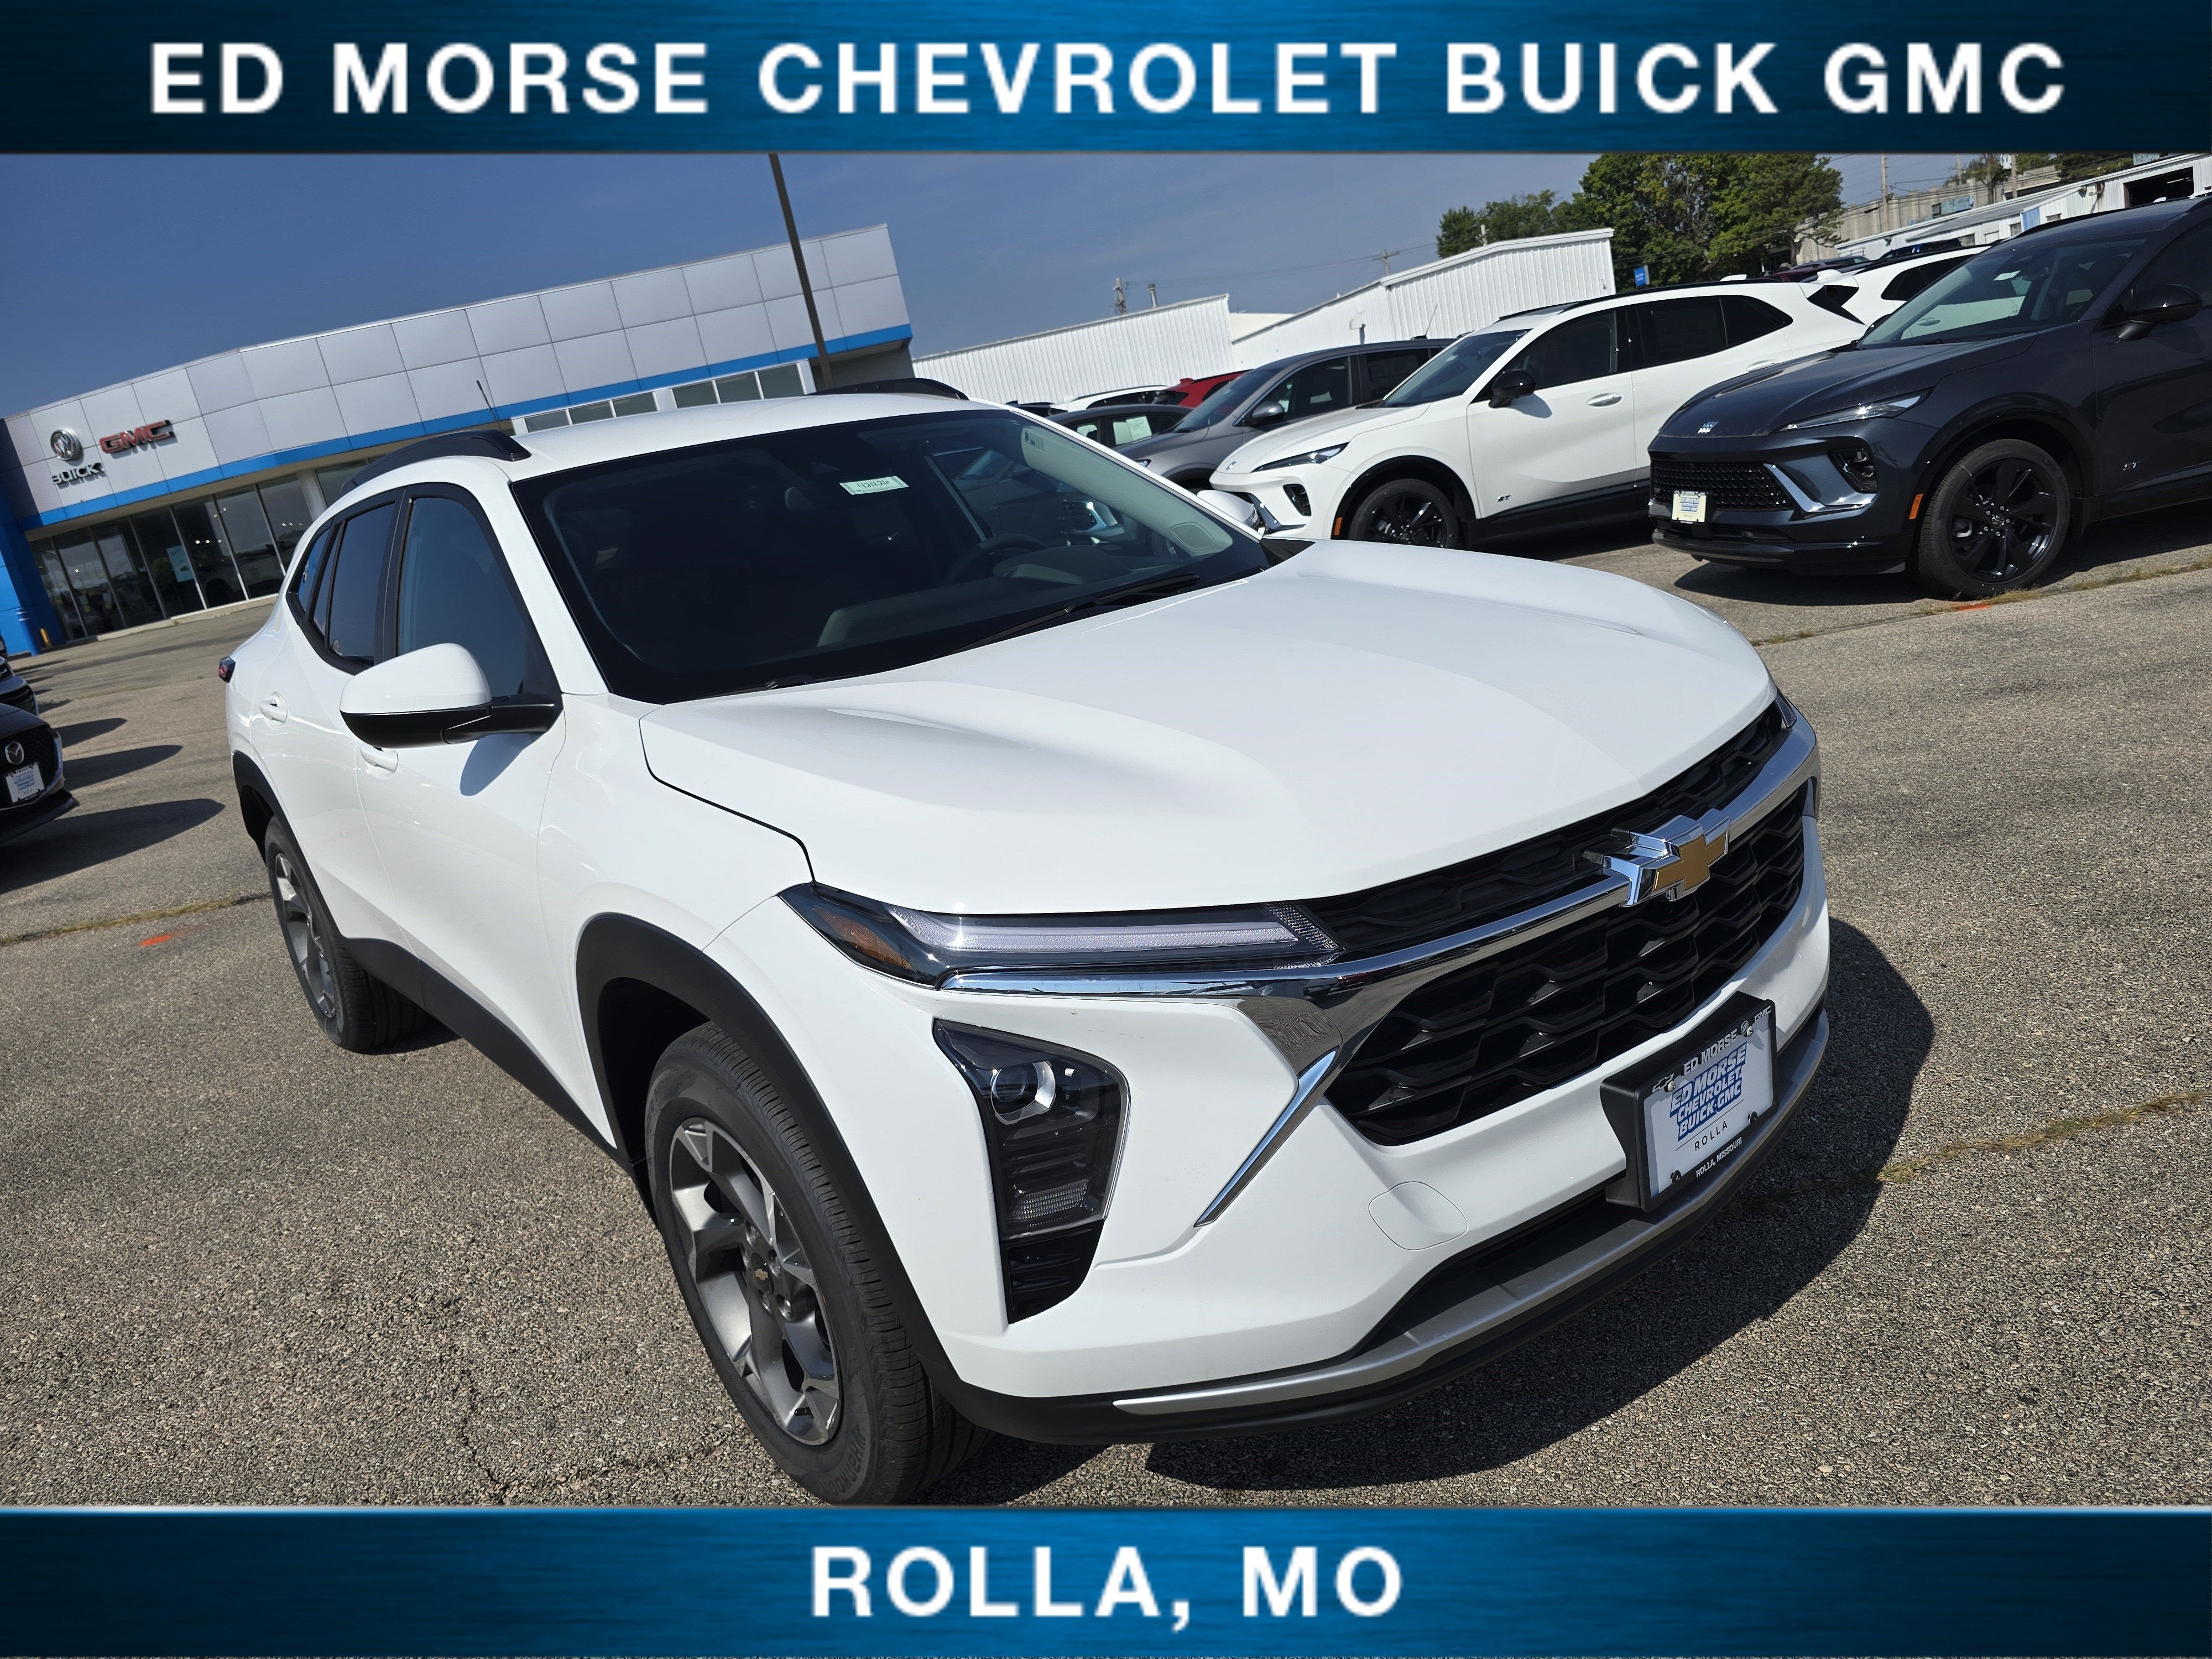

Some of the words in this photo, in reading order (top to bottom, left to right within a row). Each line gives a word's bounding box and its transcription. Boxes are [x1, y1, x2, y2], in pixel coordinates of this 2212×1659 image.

[100, 420, 173, 453] GMC
[52, 463, 104, 484] BUICK
[1754, 1005, 1771, 1023] GMC
[1683, 1056, 1699, 1076] ED
[1700, 1029, 1738, 1065] MORSE
[1671, 1082, 1692, 1113] ED
[1693, 1047, 1746, 1097] MORSE
[1694, 1120, 1728, 1152] ROLLA
[1695, 1159, 1716, 1179] ROLLA,
[1716, 1136, 1743, 1162] MISSOURI
